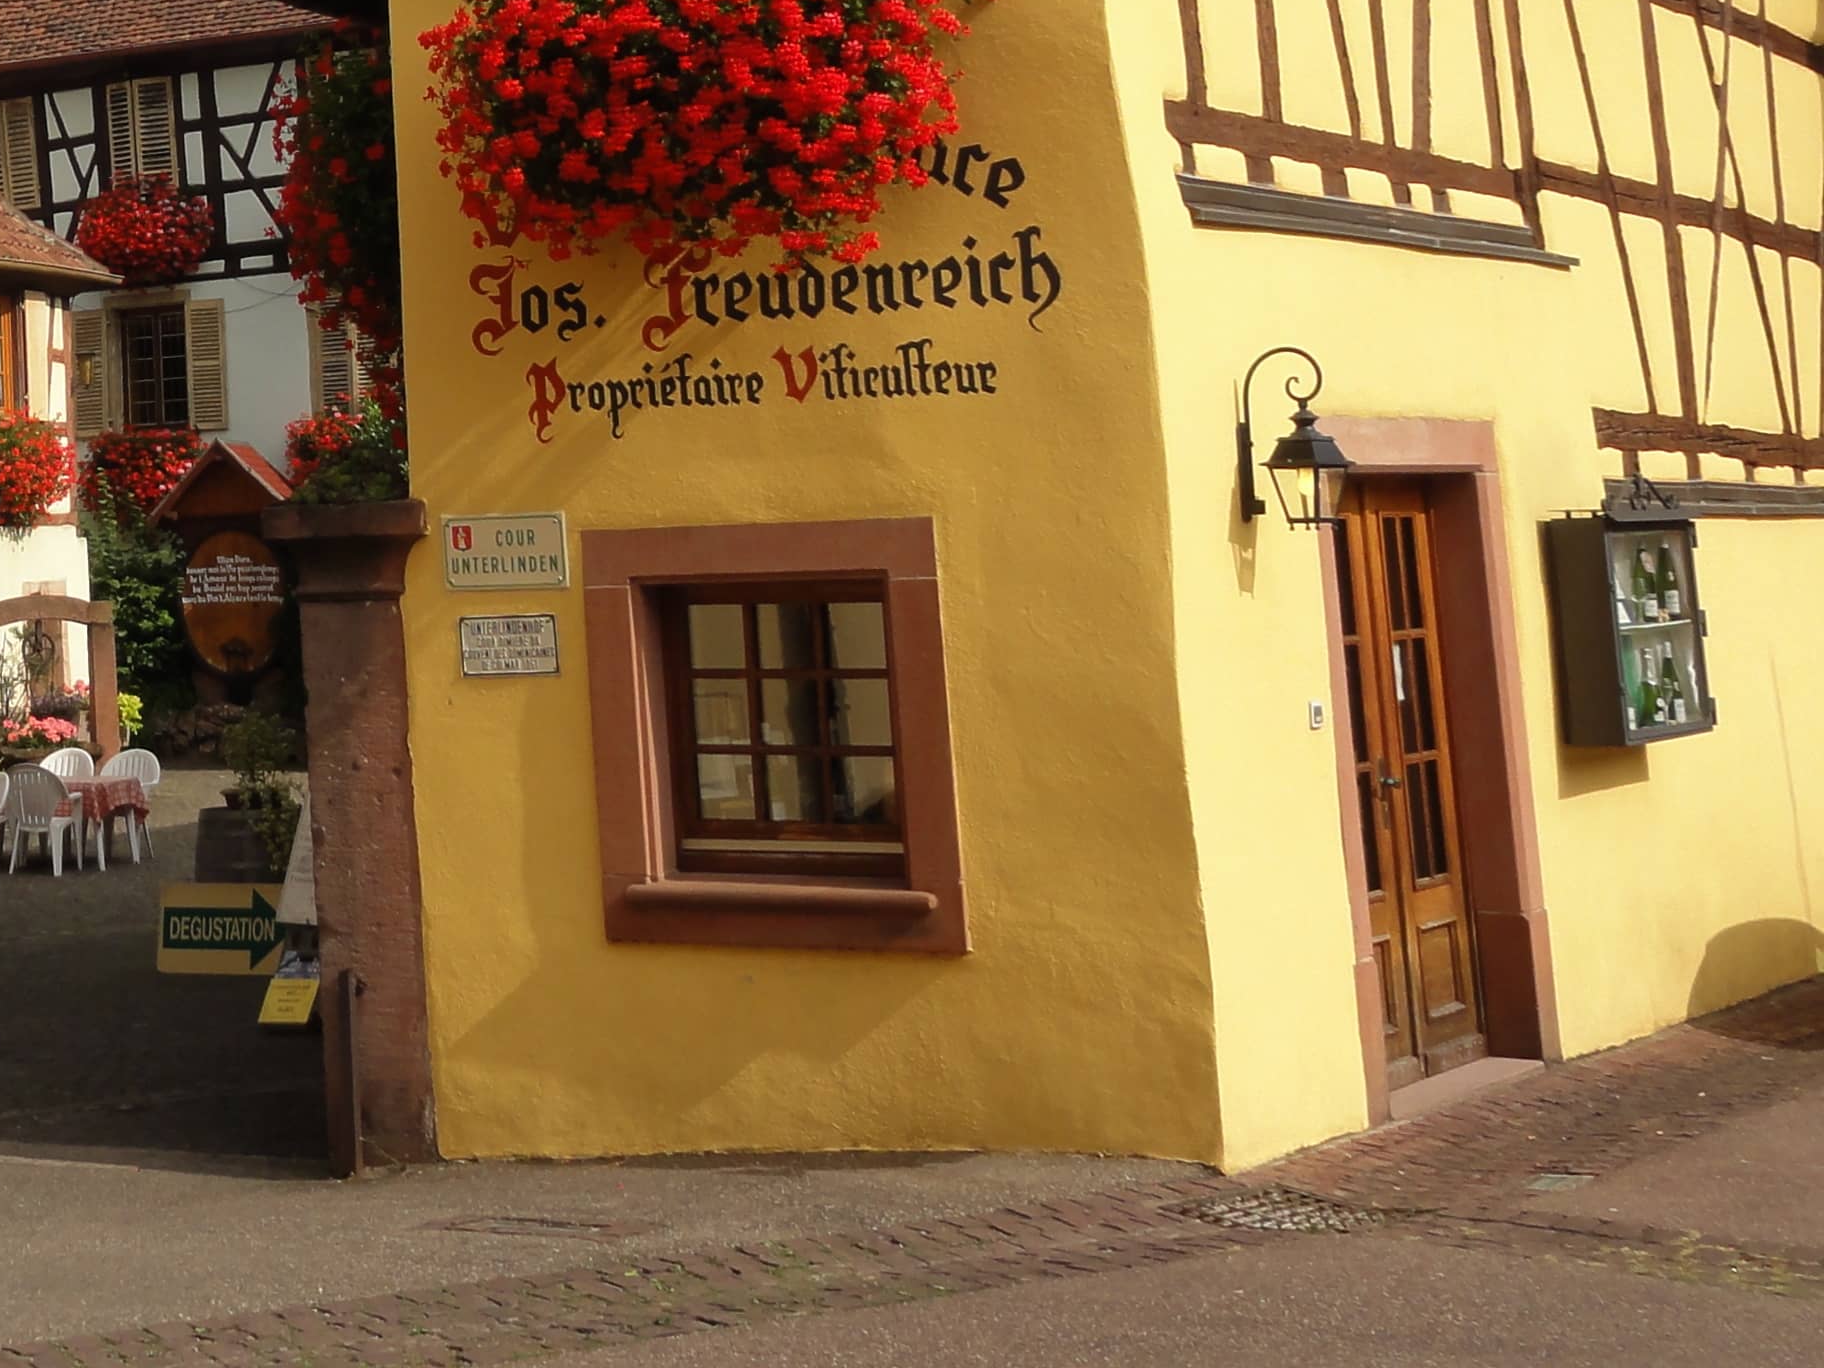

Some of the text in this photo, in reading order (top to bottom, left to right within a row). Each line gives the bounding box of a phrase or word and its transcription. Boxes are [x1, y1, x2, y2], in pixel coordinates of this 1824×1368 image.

[641, 225, 1062, 353] Freudenreich
[526, 338, 998, 444] Propriétaire Viticulteur
[495, 529, 536, 547] COUR
[451, 555, 559, 575] UNTERLINDEN
[169, 916, 276, 941] DEGUSTATION
